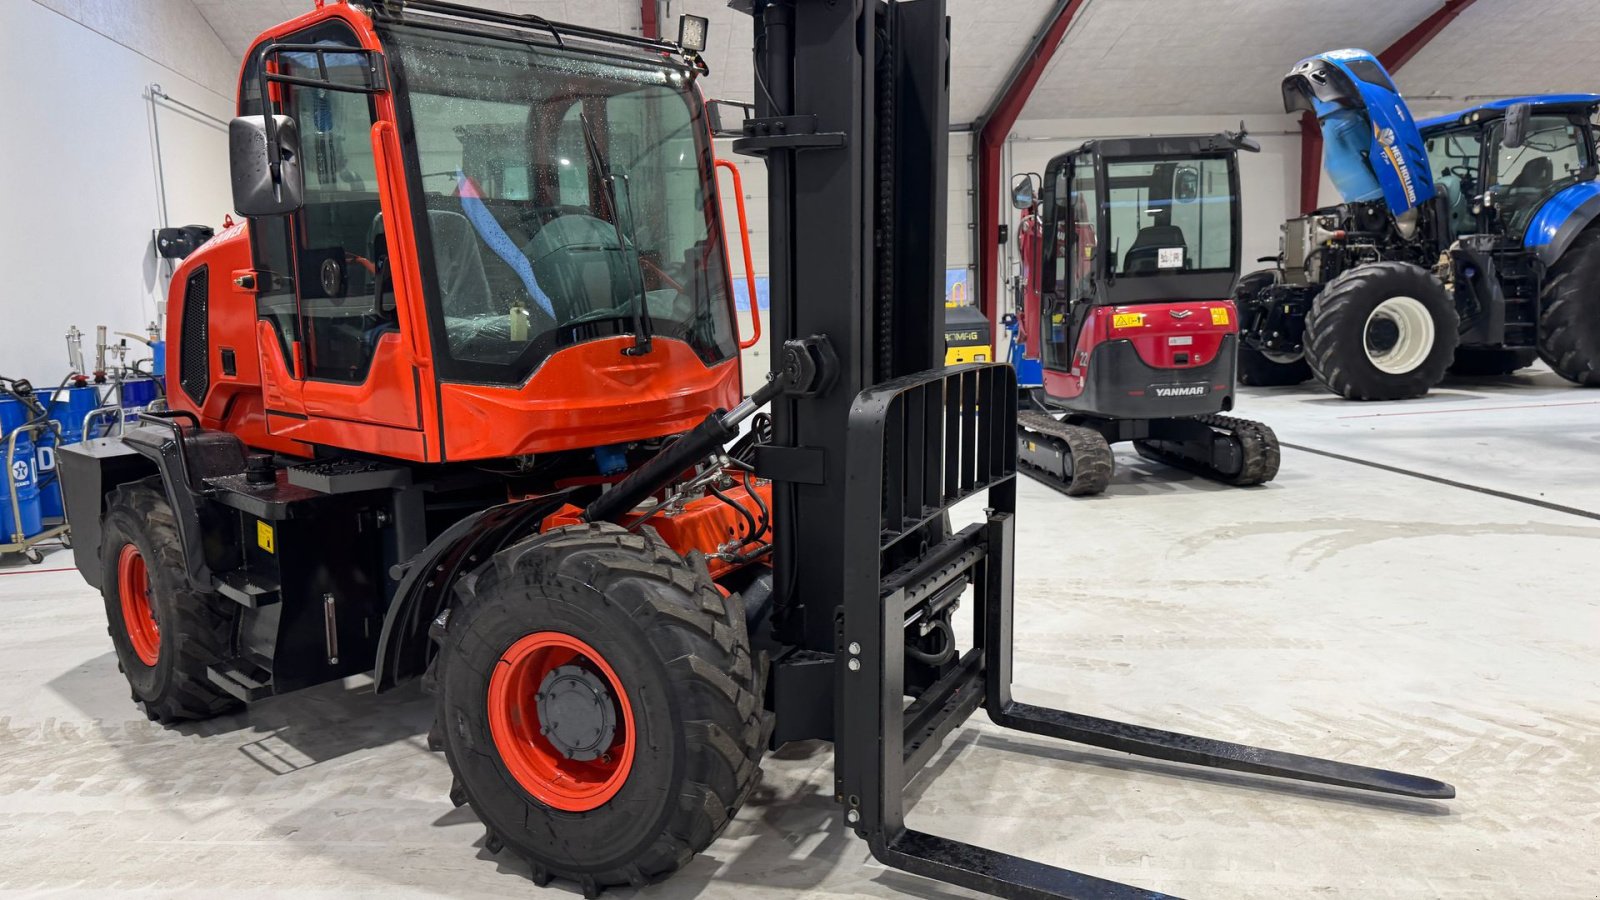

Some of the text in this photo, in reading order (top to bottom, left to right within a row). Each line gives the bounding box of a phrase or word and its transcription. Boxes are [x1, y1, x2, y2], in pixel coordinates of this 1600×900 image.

[1390, 145, 1416, 203] NEW HOLLAND
[1156, 386, 1204, 397] YANMAR
